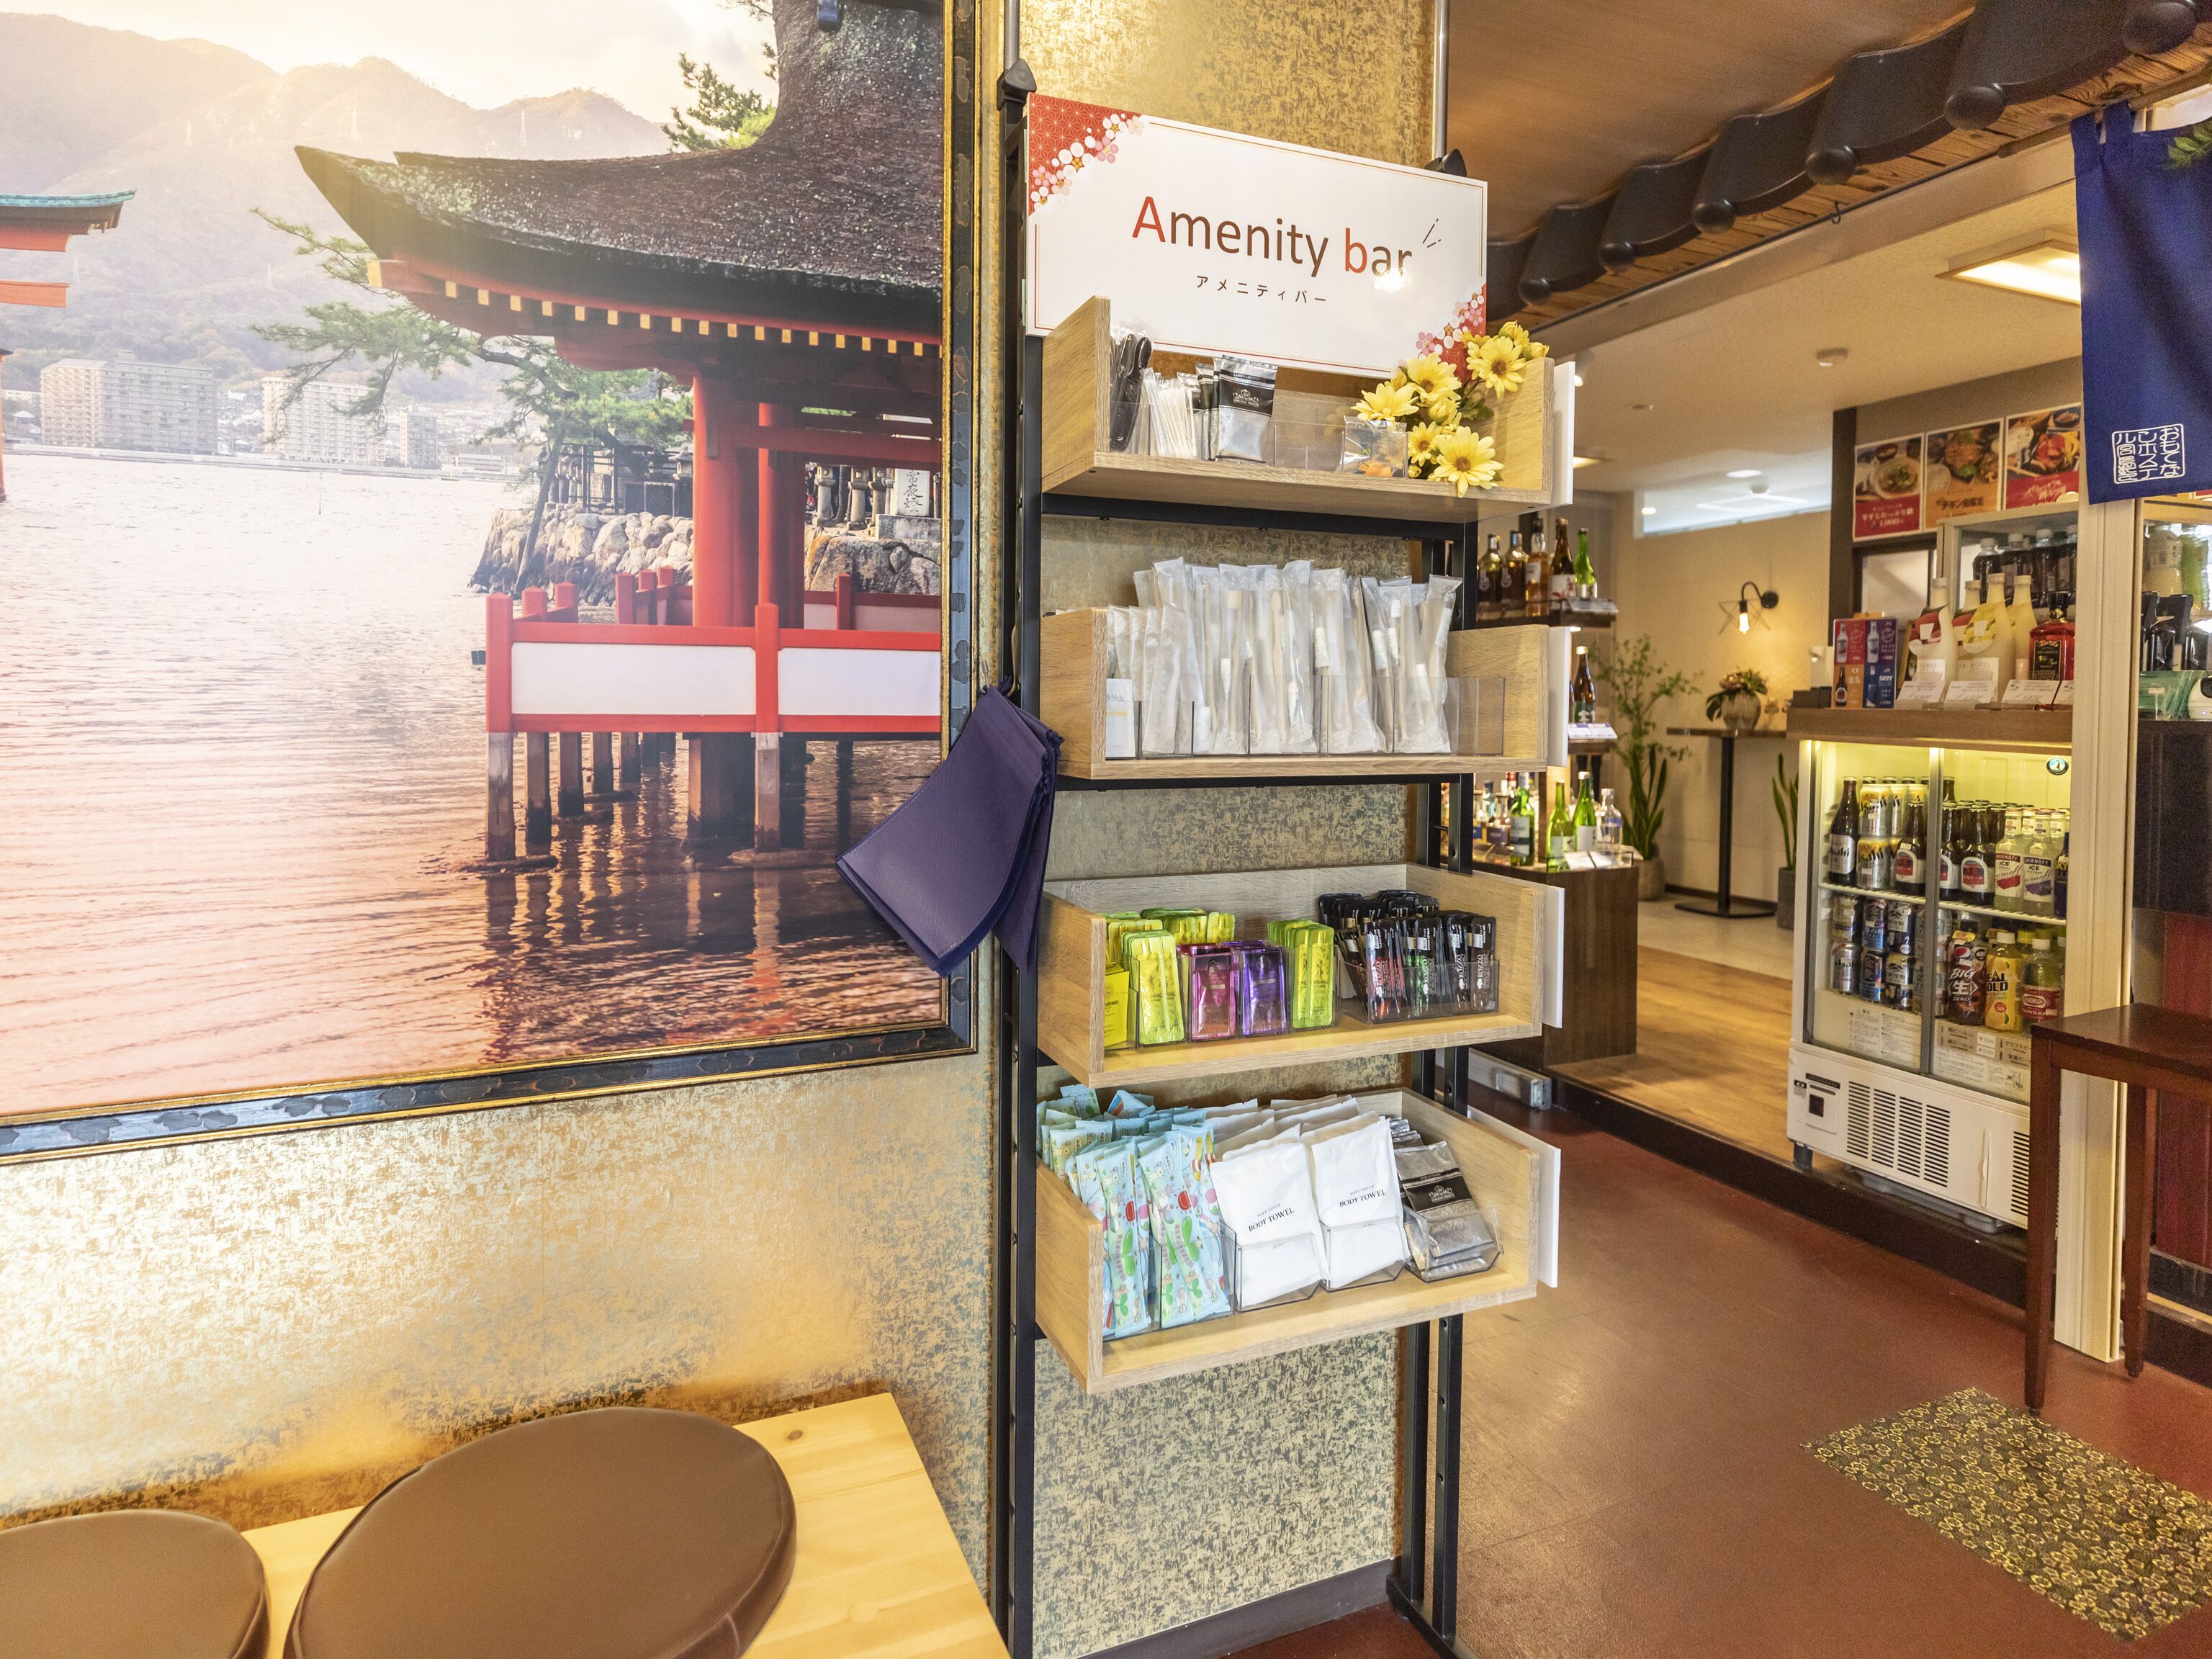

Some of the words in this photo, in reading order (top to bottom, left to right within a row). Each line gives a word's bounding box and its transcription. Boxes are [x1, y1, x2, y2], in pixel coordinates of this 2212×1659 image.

[1132, 196, 1329, 278] Amenity
[1344, 227, 1412, 277] bar
[1196, 275, 1326, 303] アメニティバー
[1949, 968, 1977, 979] BIG
[1952, 979, 1970, 995] 生
[1339, 1197, 1359, 1208] BODY
[1359, 1189, 1387, 1202] TOWEL
[1248, 1218, 1267, 1232] BODY
[1267, 1207, 1295, 1223] TOWEL
